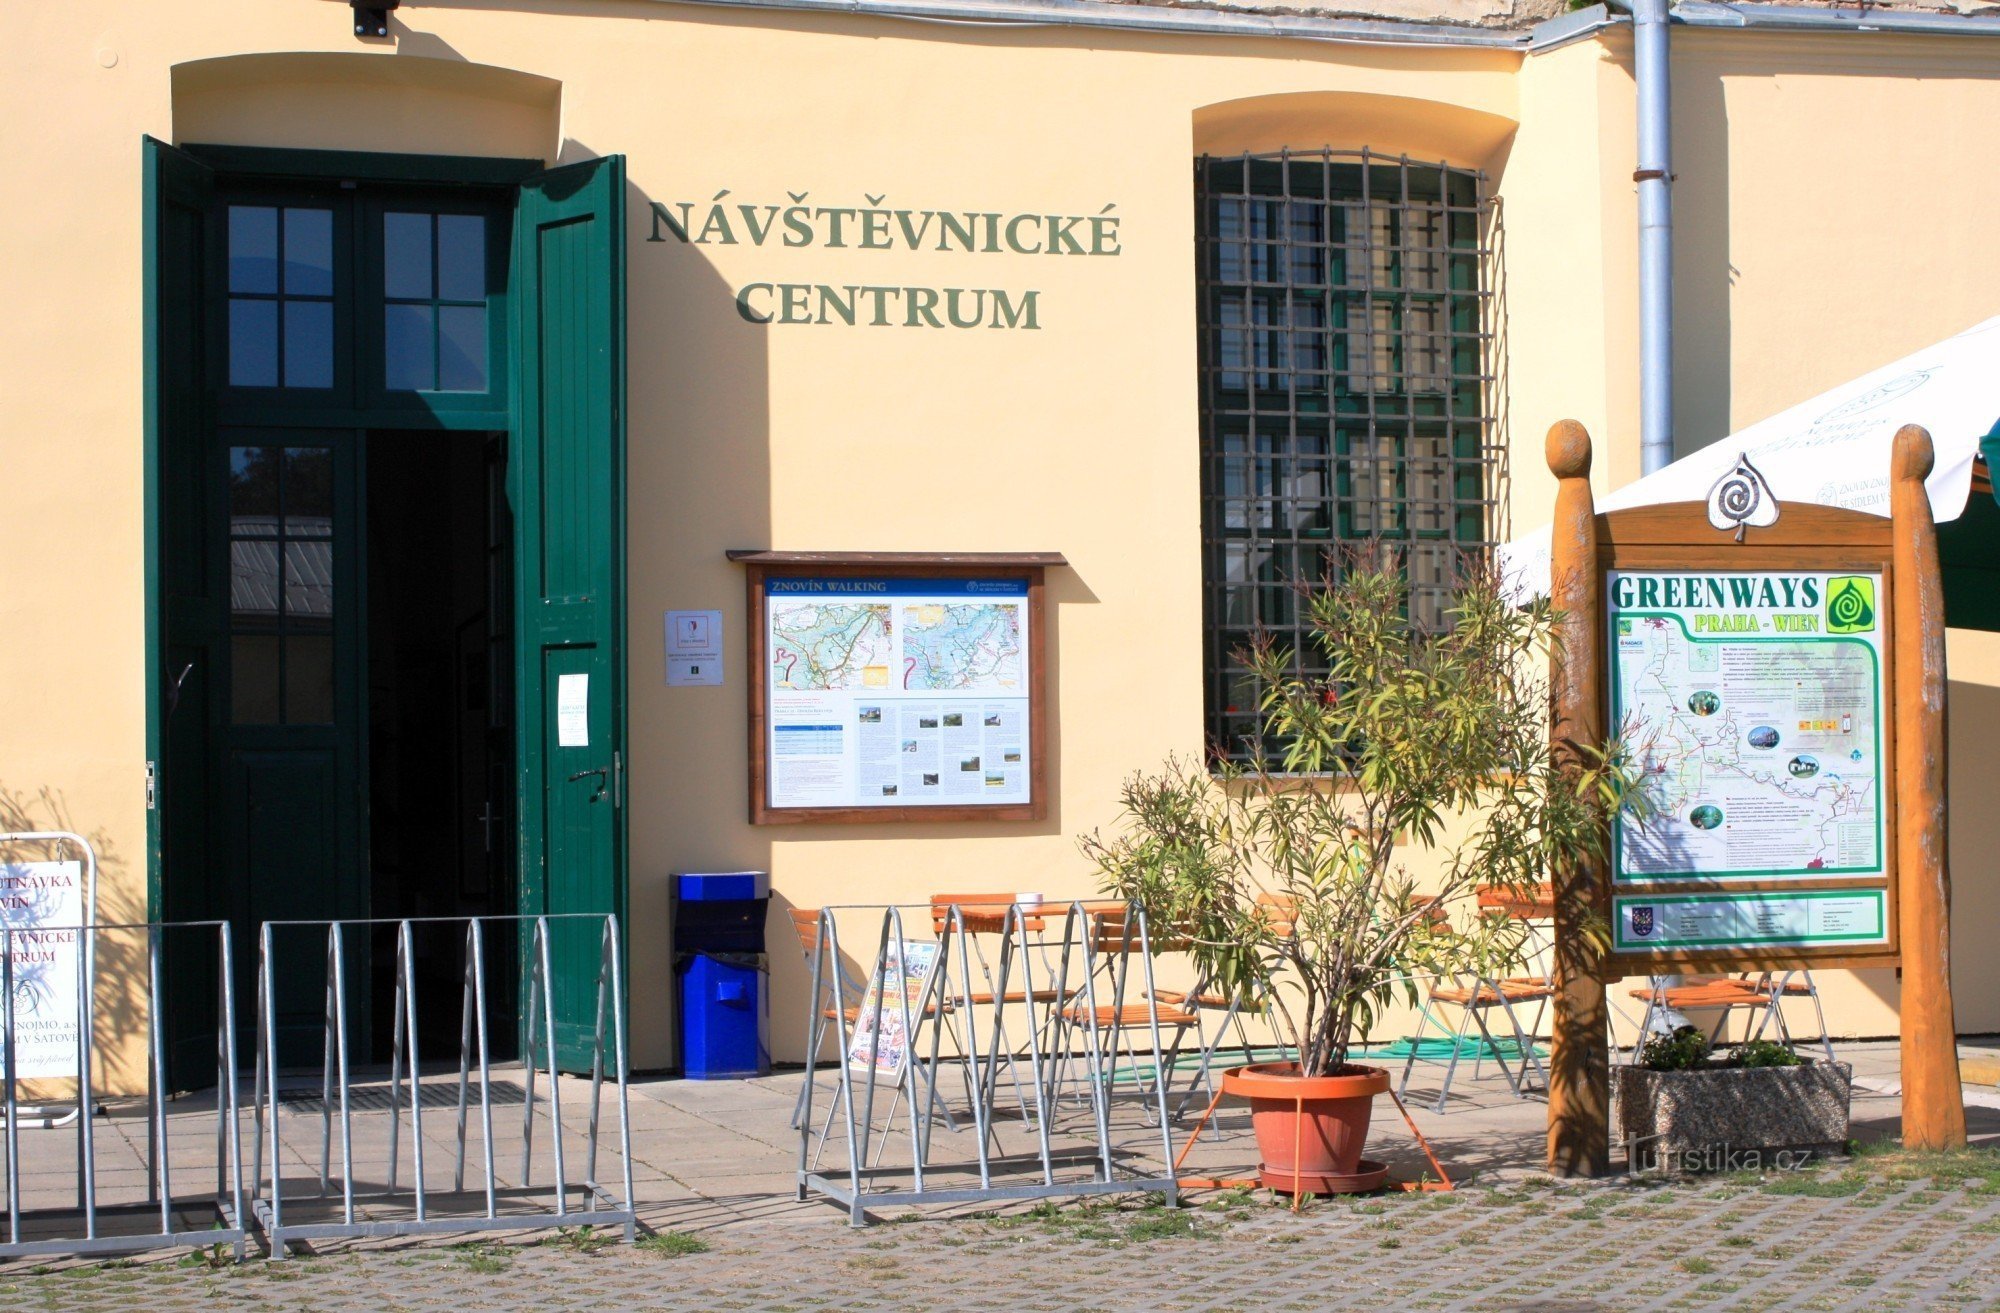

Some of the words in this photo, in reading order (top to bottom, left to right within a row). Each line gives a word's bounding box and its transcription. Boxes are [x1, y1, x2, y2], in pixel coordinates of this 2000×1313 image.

[646, 189, 1122, 256] NÁVŠTĚVNICKÉ
[736, 283, 1042, 330] CENTRUM
[772, 578, 824, 593] ZNOVÍN
[827, 581, 887, 592] WALKING
[1611, 577, 1819, 608] GREENWAYS
[1694, 614, 1760, 632] PRAHA
[1772, 614, 1819, 632] WIEN
[0, 928, 75, 945] ĚVNICKÉ
[0, 952, 55, 963] TRUM
[13, 1021, 61, 1031] NOJMO,
